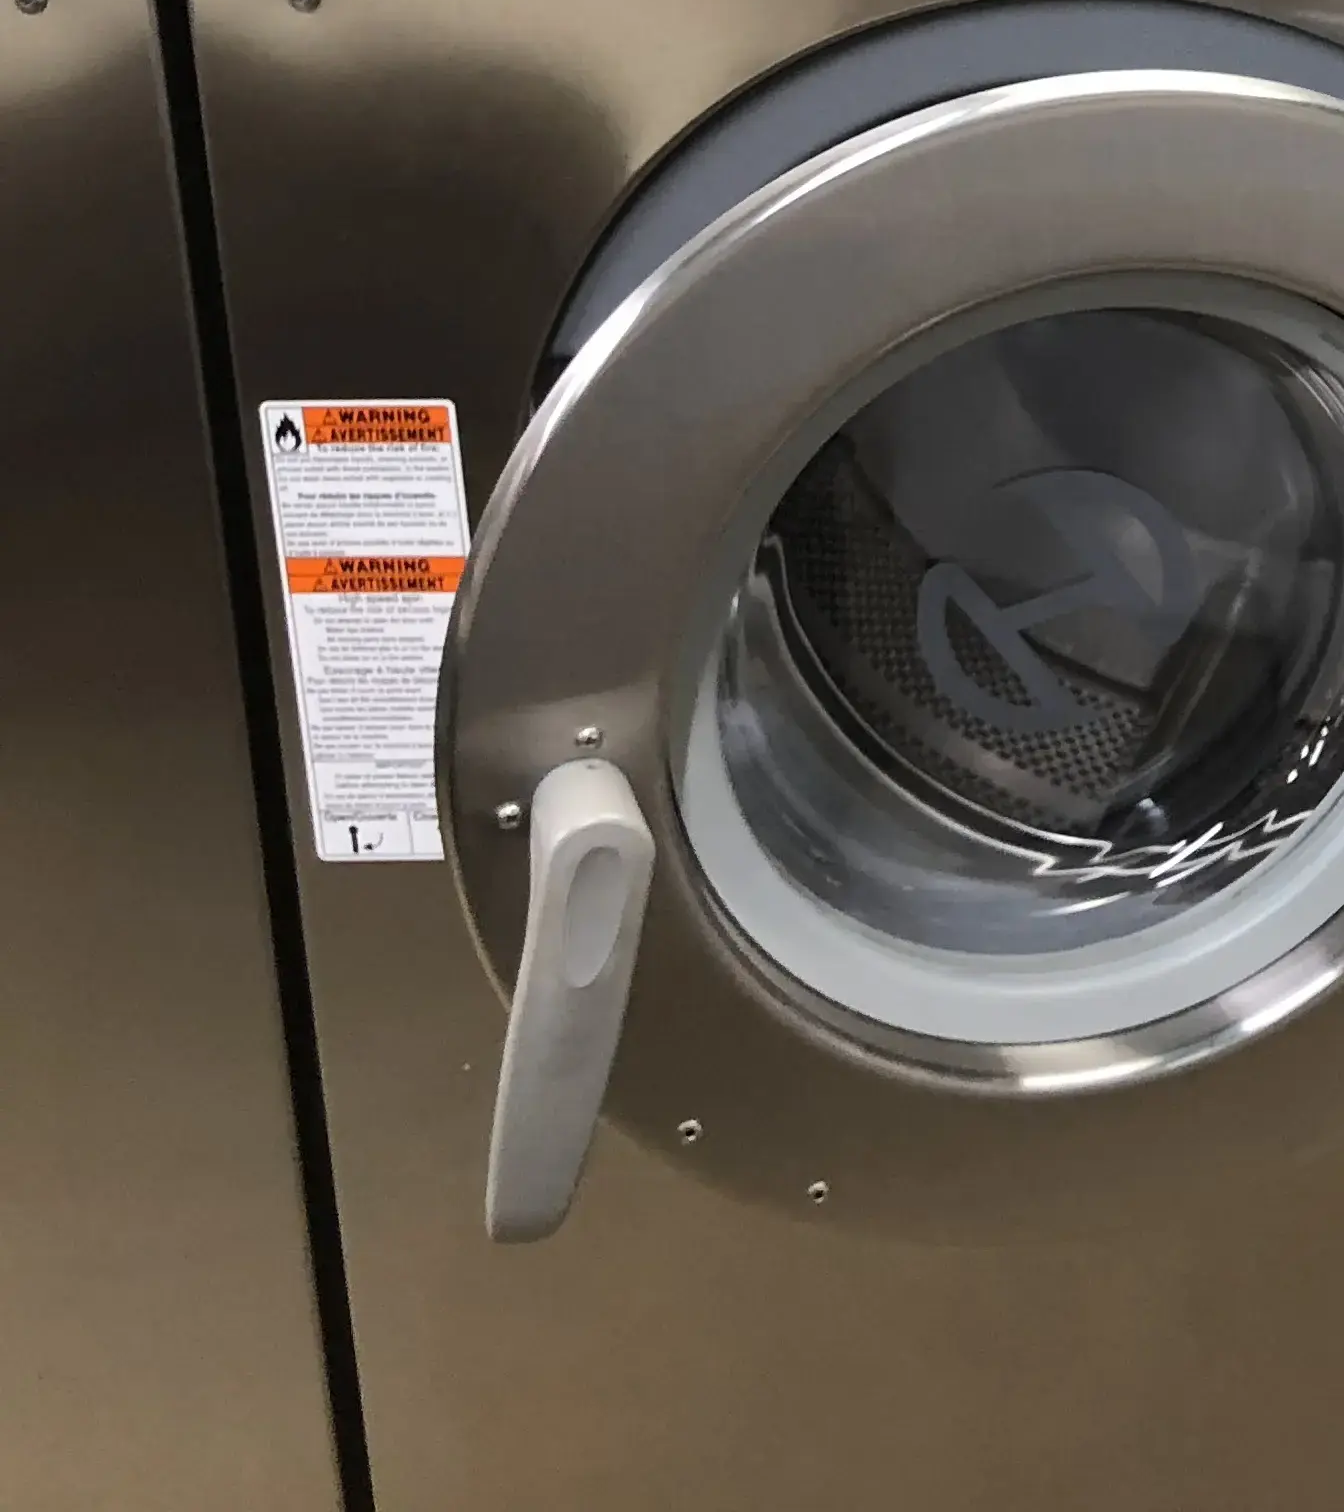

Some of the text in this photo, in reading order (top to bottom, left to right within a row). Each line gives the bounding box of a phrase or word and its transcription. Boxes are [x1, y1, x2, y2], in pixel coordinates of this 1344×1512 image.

[338, 409, 430, 424] WARNING
[330, 429, 445, 442] AVERTISSEMENT
[340, 558, 430, 574] WARNING
[331, 578, 445, 592] AVERTISSEMENT
